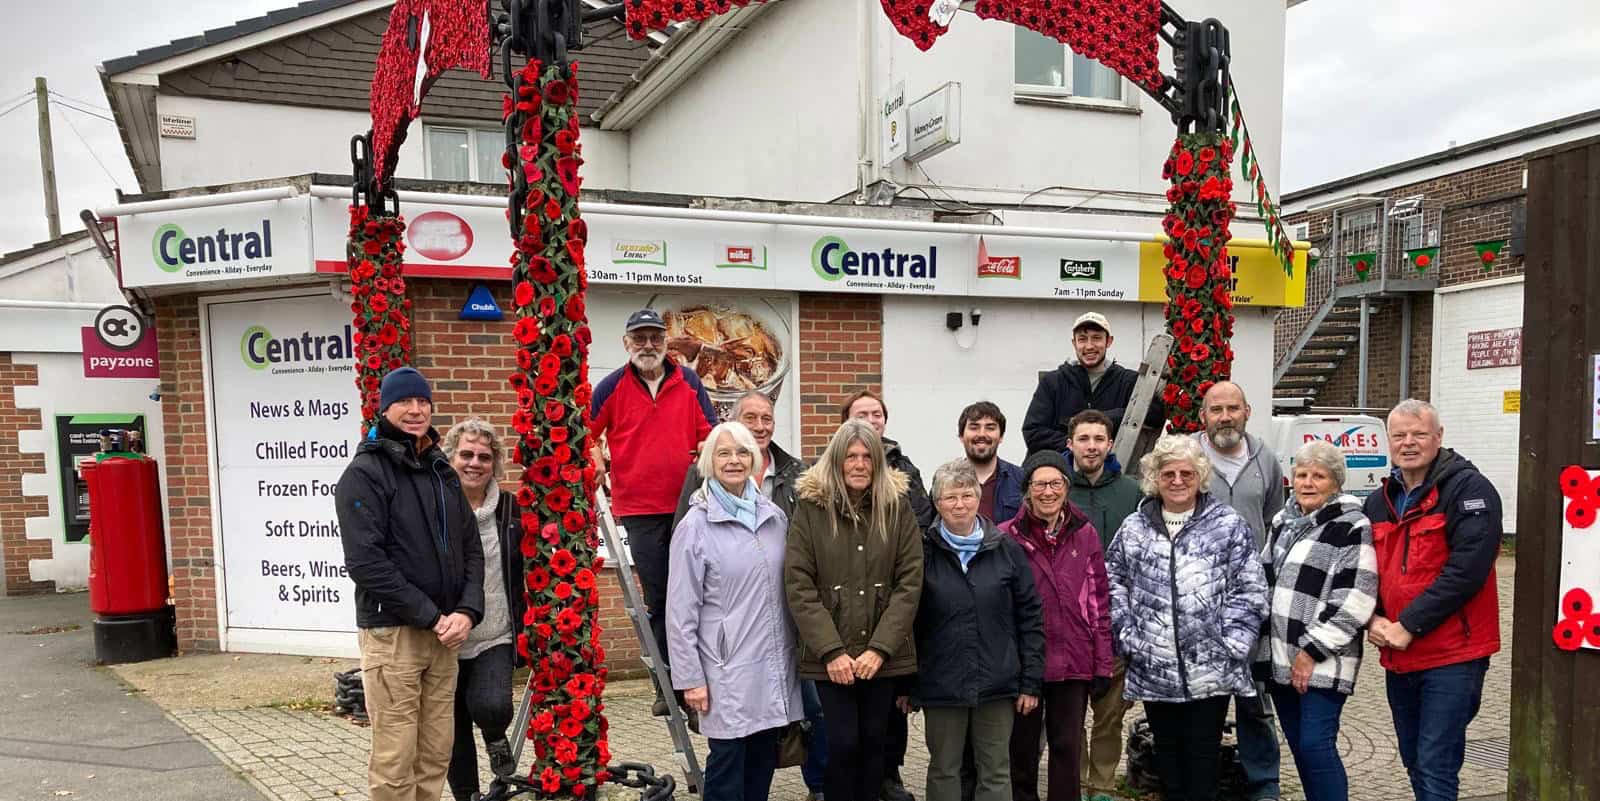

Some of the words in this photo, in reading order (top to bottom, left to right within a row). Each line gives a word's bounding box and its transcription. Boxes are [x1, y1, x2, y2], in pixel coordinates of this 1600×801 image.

[885, 88, 903, 117] Central
[160, 219, 272, 265] Central
[821, 242, 937, 279] Central
[1064, 261, 1096, 276] Carlsberg
[186, 268, 221, 277] Convenience
[225, 266, 242, 275] Allday
[246, 264, 272, 273] Everyday
[584, 270, 618, 280] .30am
[626, 271, 652, 283] 11pm
[654, 273, 674, 282] Mon
[676, 274, 686, 283] to
[687, 274, 702, 284] Sat
[846, 280, 883, 288] Convenience
[887, 281, 905, 290] Allday
[909, 283, 935, 292] Everyday
[1054, 287, 1070, 296] 7am
[1076, 288, 1096, 299] 11pm
[1097, 288, 1124, 300] Sunday
[248, 325, 353, 364] Central
[90, 357, 154, 370] payzone
[272, 367, 305, 375] Convenience
[308, 365, 325, 374] Allday
[328, 365, 353, 373] Everyday
[250, 401, 290, 418] News
[293, 400, 305, 417] &
[309, 399, 349, 420] Mags
[256, 441, 306, 460] Chilled
[311, 440, 348, 458] Food
[258, 480, 308, 497] Frozen
[311, 480, 337, 497] Foo
[265, 520, 295, 537] Soft
[299, 520, 340, 537] Drink
[261, 560, 306, 579] Beers,
[309, 560, 348, 578] Wine
[278, 584, 289, 602] &
[292, 585, 340, 606] Spirits
